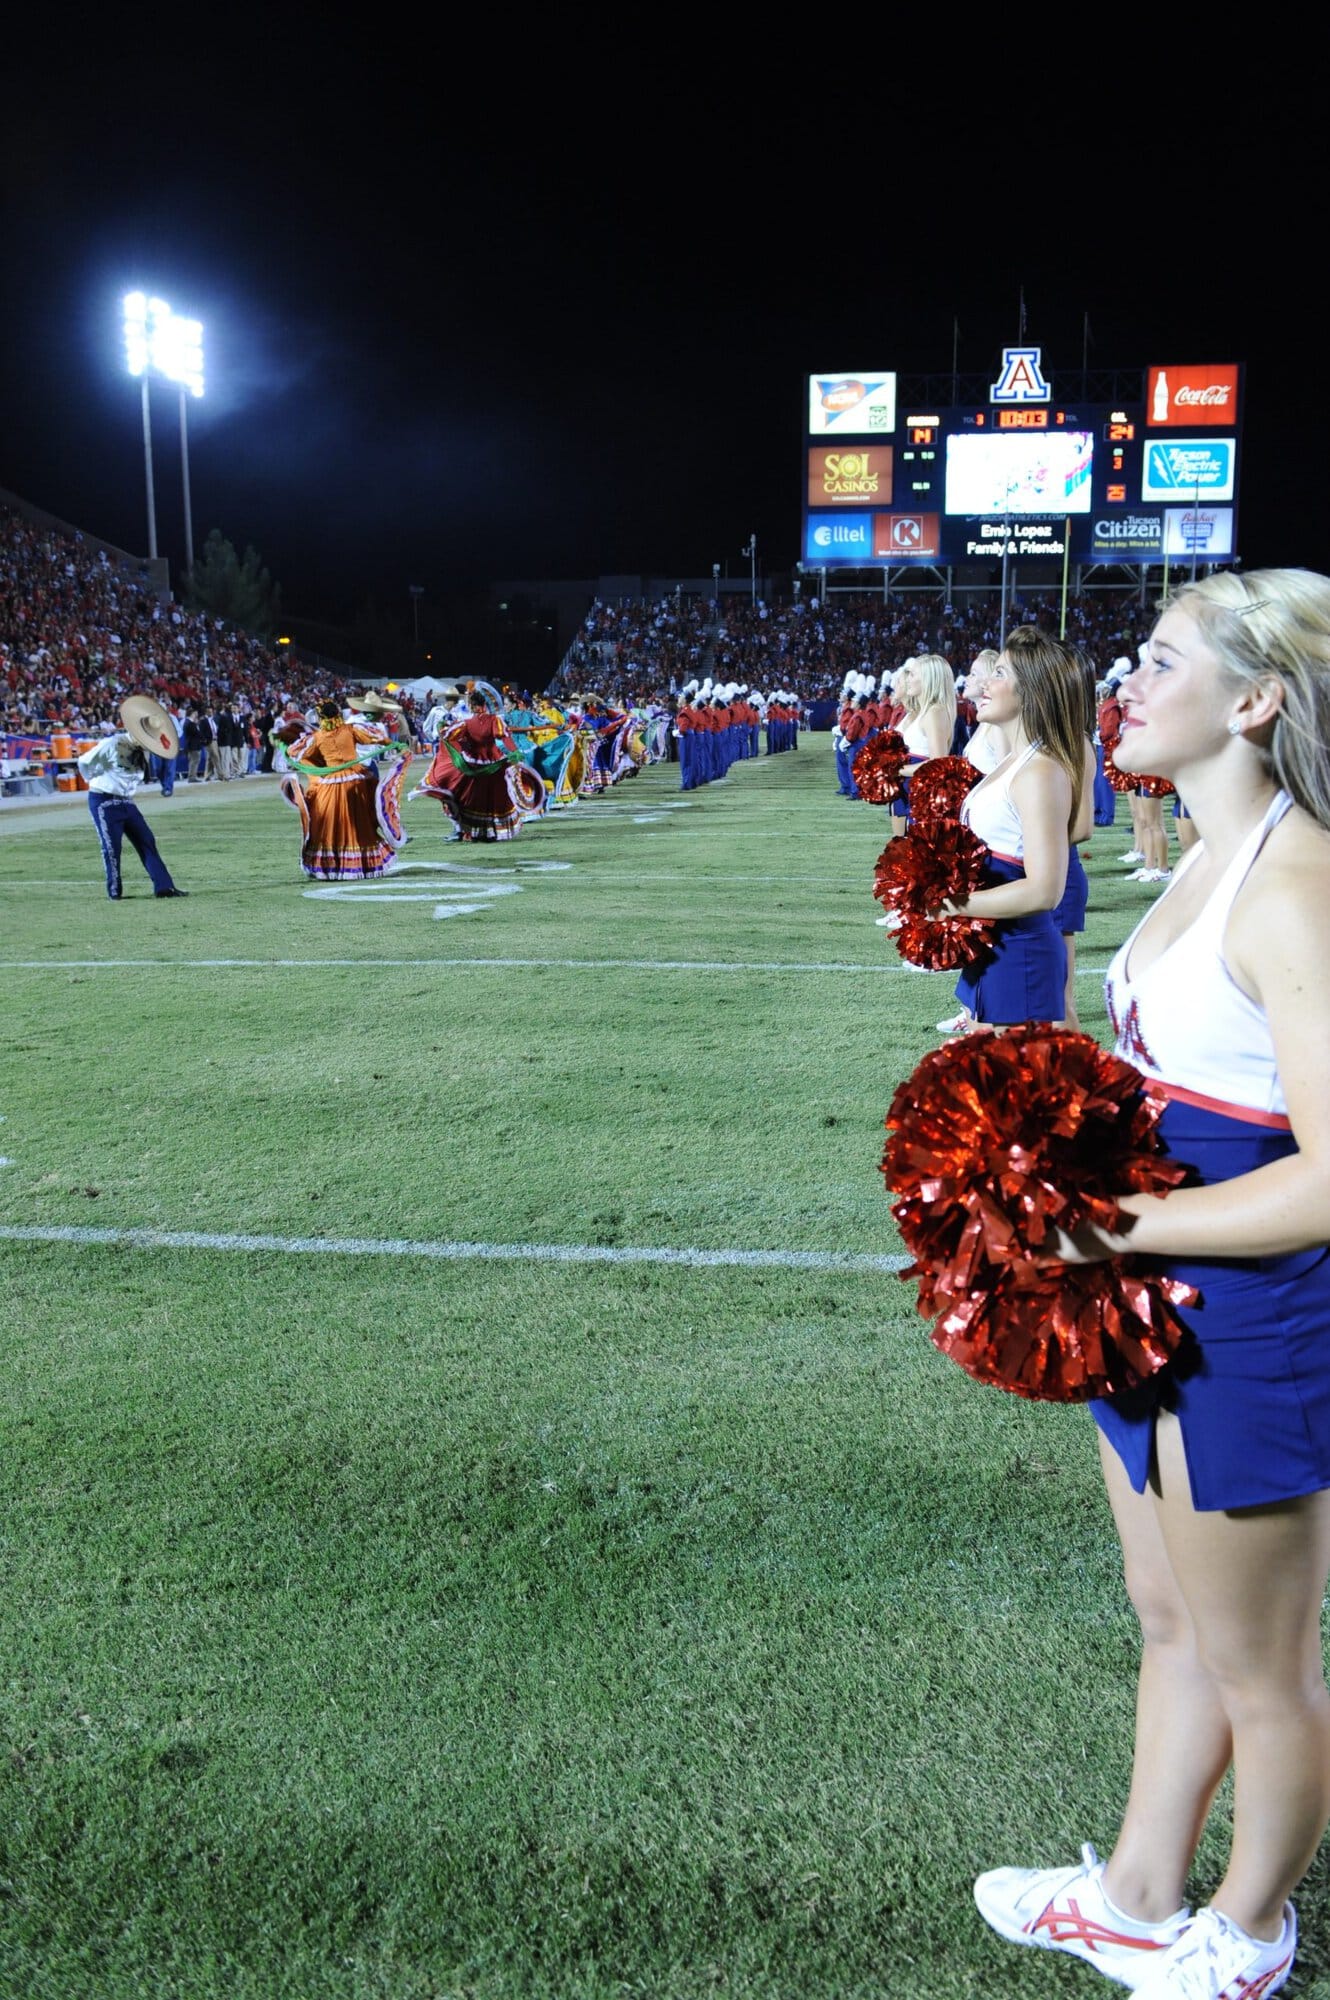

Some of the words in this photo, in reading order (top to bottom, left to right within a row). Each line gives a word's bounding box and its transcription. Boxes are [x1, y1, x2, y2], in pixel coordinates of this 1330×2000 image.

[990, 348, 1051, 403] A
[1110, 424, 1134, 440] 24
[823, 453, 879, 481] SOL
[823, 480, 879, 493] CASINOS
[1127, 516, 1160, 524] Tucson
[1014, 524, 1052, 539] Lopez
[1094, 520, 1161, 538] Citizen
[967, 542, 1006, 557] Family
[1007, 541, 1018, 554] &
[1020, 541, 1064, 554] Friends
